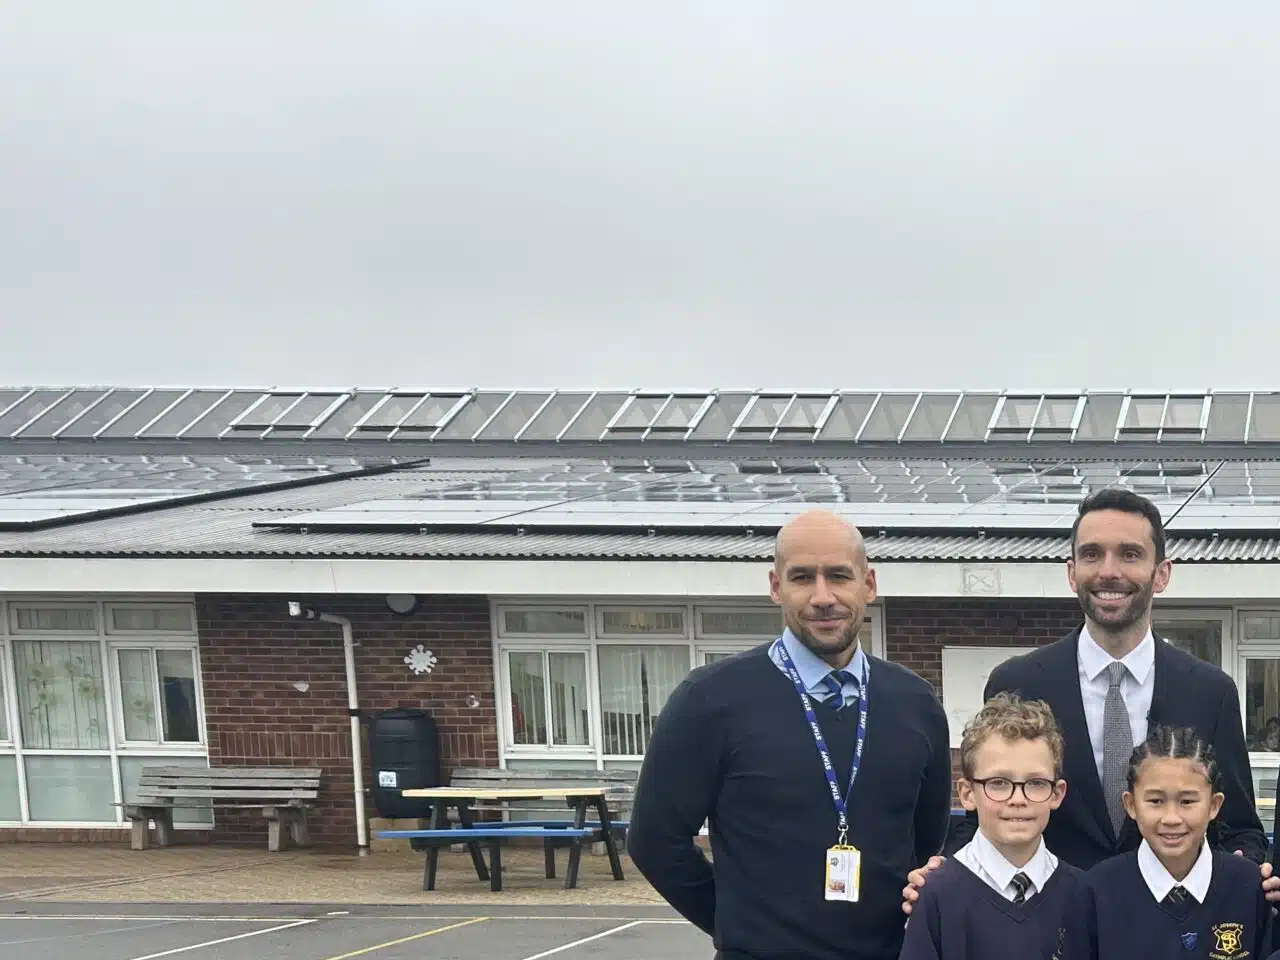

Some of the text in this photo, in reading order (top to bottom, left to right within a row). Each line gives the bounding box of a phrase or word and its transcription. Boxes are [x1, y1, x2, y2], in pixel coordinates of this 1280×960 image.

[789, 668, 801, 684] STAFF
[801, 694, 812, 711] STAFF
[811, 722, 822, 740] STAFF
[821, 751, 832, 770] STAFF
[830, 781, 840, 800] STAFF
